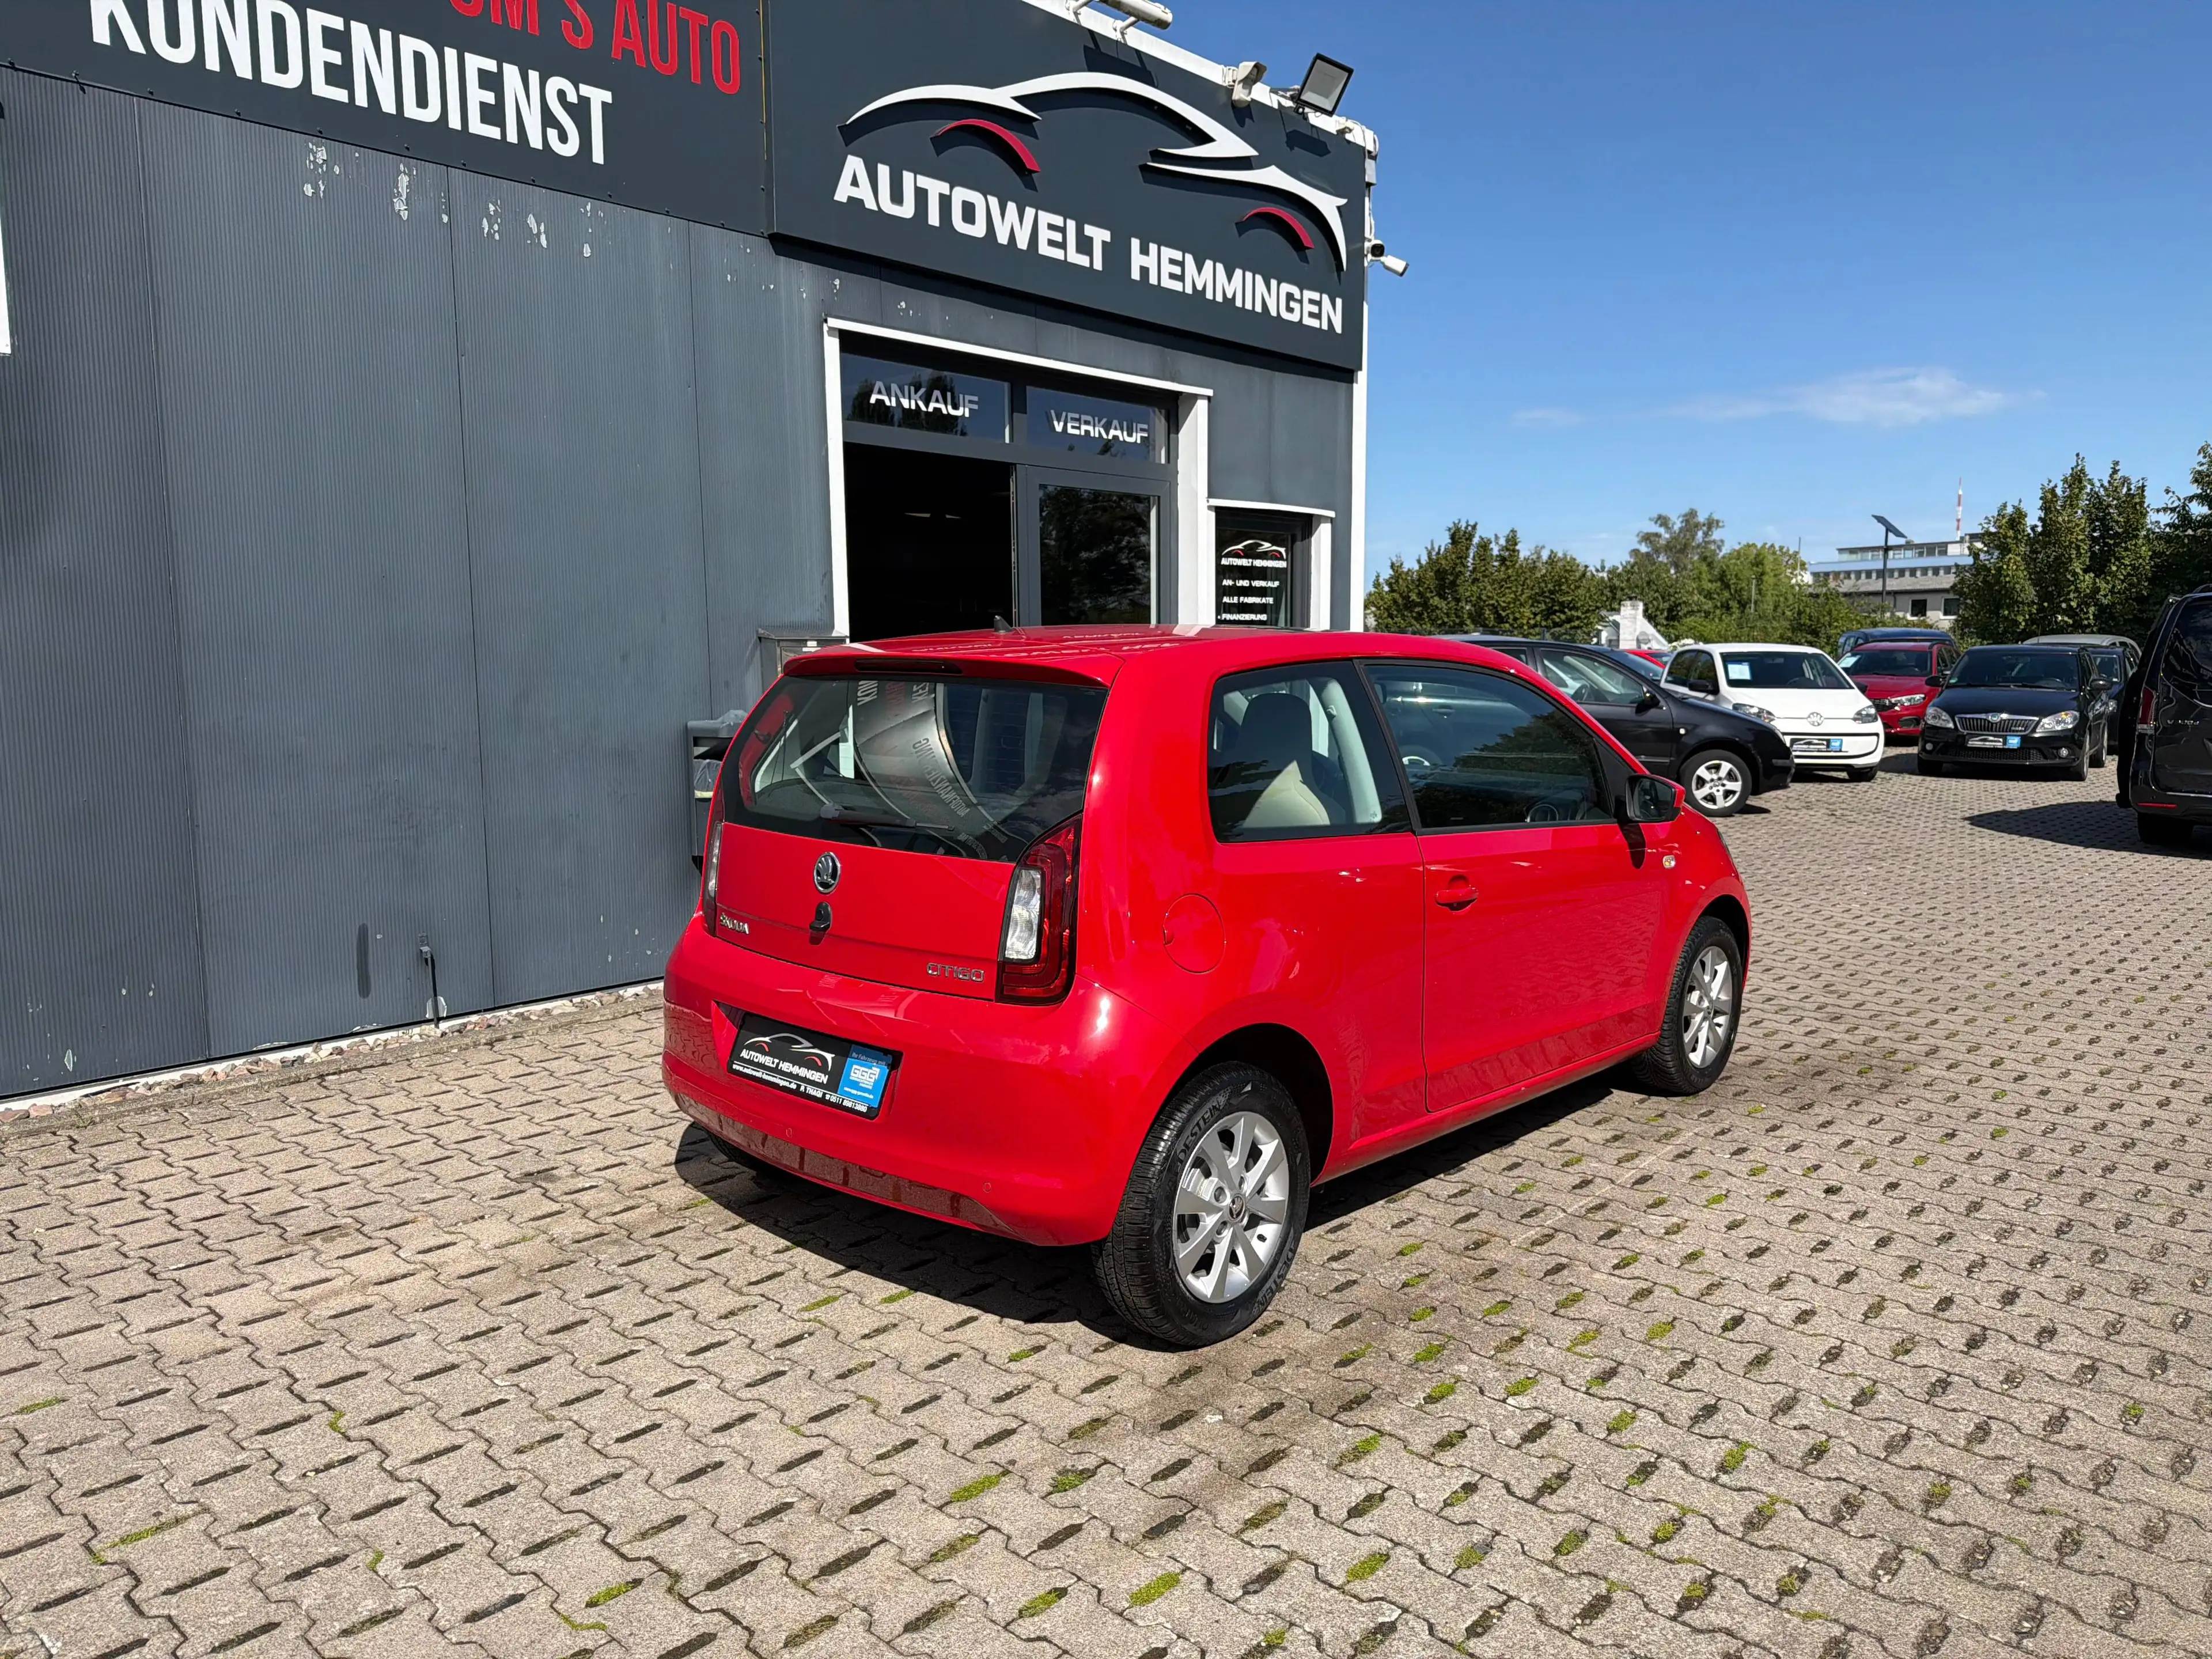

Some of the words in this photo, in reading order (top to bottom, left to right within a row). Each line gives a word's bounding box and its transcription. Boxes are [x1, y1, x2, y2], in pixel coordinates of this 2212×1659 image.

[834, 154, 1111, 271] AUTOWELT
[1131, 237, 1342, 334] HEMMINGEN
[869, 381, 979, 418] ANKAUF
[1050, 409, 1149, 444] VERKAUF
[1221, 558, 1252, 566] AUTOWELT
[927, 963, 984, 982] CITIGO
[740, 1048, 779, 1070] AUTOWELT
[779, 1060, 828, 1084] HEMMINGEN
[830, 1095, 842, 1104] 0511
[843, 1099, 868, 1113] 89813880
